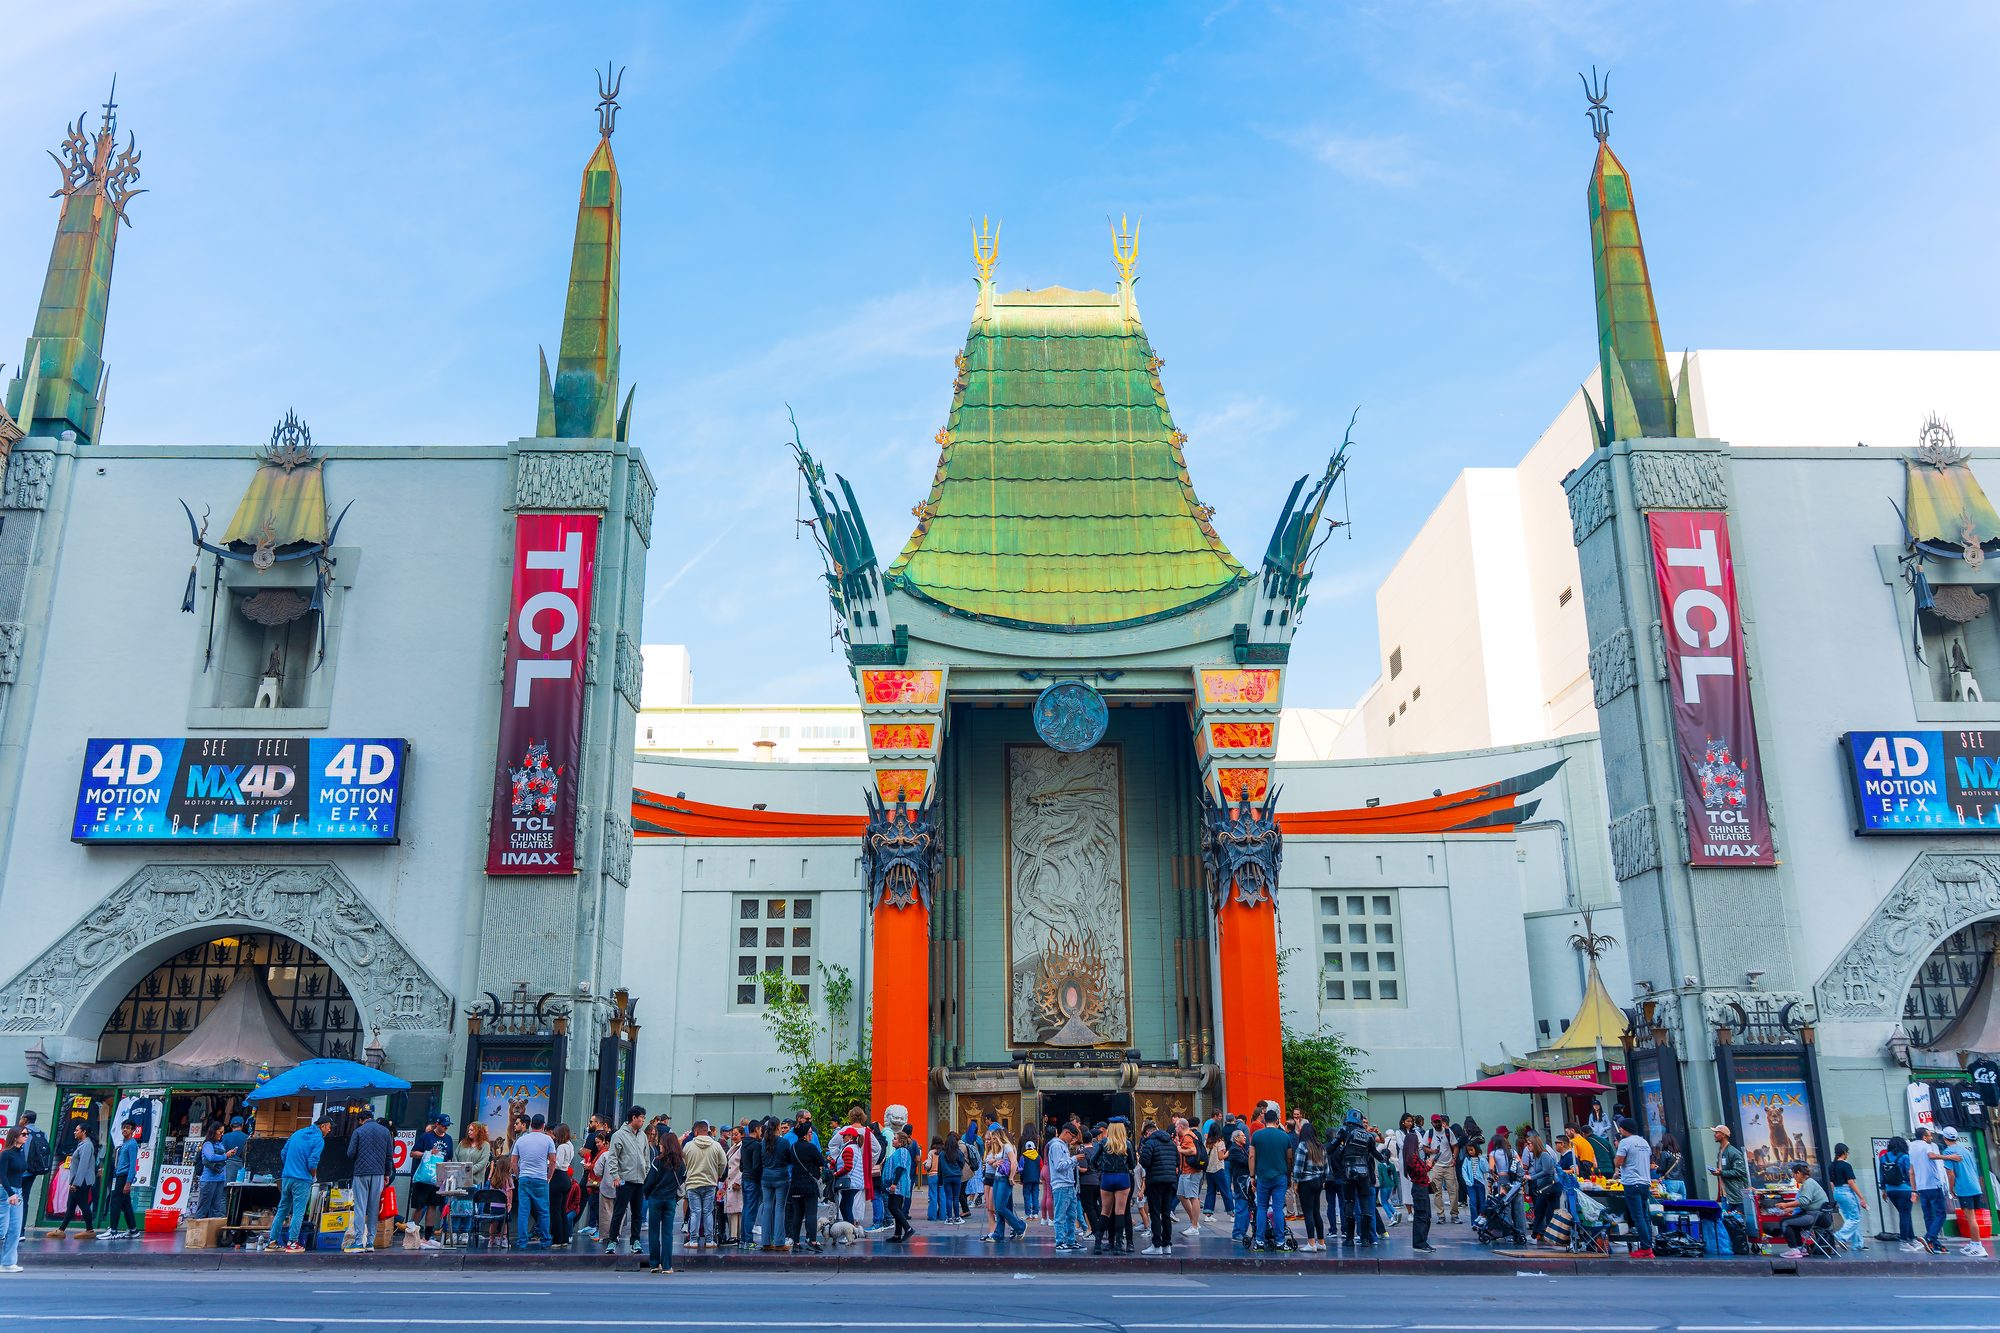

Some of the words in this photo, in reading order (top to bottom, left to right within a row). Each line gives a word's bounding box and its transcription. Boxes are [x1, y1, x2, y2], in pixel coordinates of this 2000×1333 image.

[513, 531, 583, 708] TCL
[1666, 529, 1734, 704] TCL
[1961, 732, 1984, 748] SEE
[202, 740, 228, 756] SEE
[257, 740, 288, 756] FEEL
[92, 744, 163, 785] 4D
[324, 744, 395, 785] 4D
[1863, 737, 1929, 777] 4D
[1865, 780, 1937, 796] MOTION
[86, 788, 160, 804] MOTION
[320, 788, 394, 804] MOTION
[1882, 798, 1928, 812] EFX
[96, 807, 145, 821] EFX
[331, 807, 379, 820] EFX
[1706, 810, 1749, 824] TCL
[1872, 815, 1943, 823] THEATRE
[172, 814, 300, 835] BELIEVE
[512, 817, 554, 831] TCL
[510, 833, 553, 841] CHINESE
[502, 852, 560, 864] IMAX
[1704, 845, 1760, 856] IMAX
[487, 1084, 550, 1098] IMAX
[1742, 1093, 1804, 1107] IMAX
